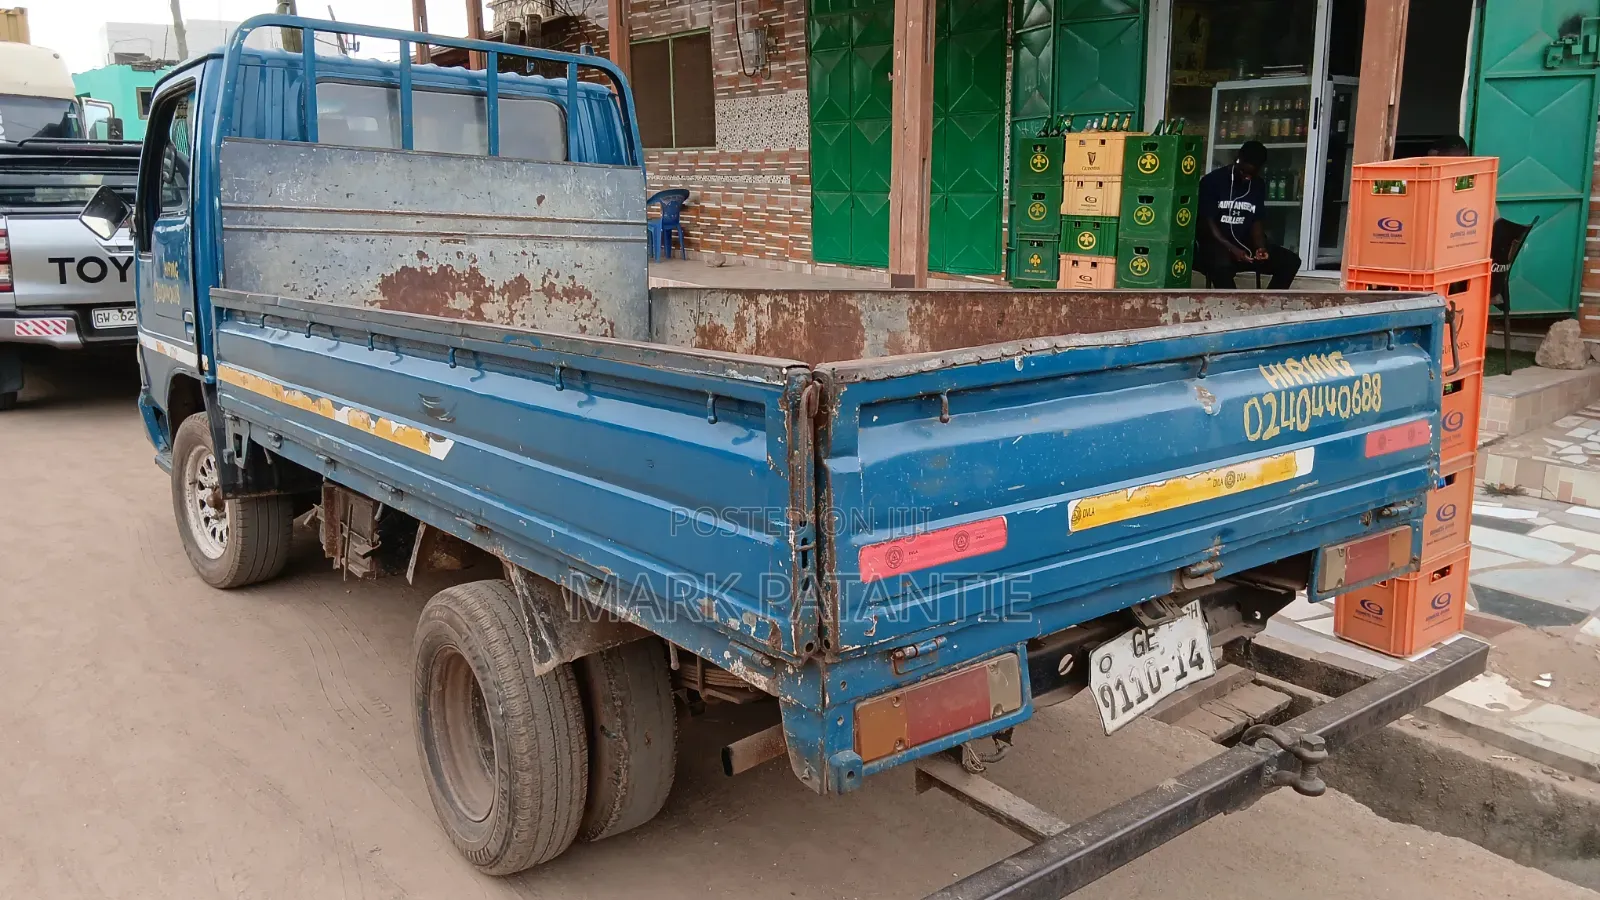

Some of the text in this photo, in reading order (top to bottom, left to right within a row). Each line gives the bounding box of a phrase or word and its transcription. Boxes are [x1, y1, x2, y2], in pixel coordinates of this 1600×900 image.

[96, 310, 137, 323] GW 62
[1258, 351, 1355, 389] HIRING
[1243, 373, 1382, 441] 0240440688
[1082, 507, 1095, 519] DVLA
[1131, 627, 1160, 658] GE
[1099, 638, 1205, 721] 9110-14
